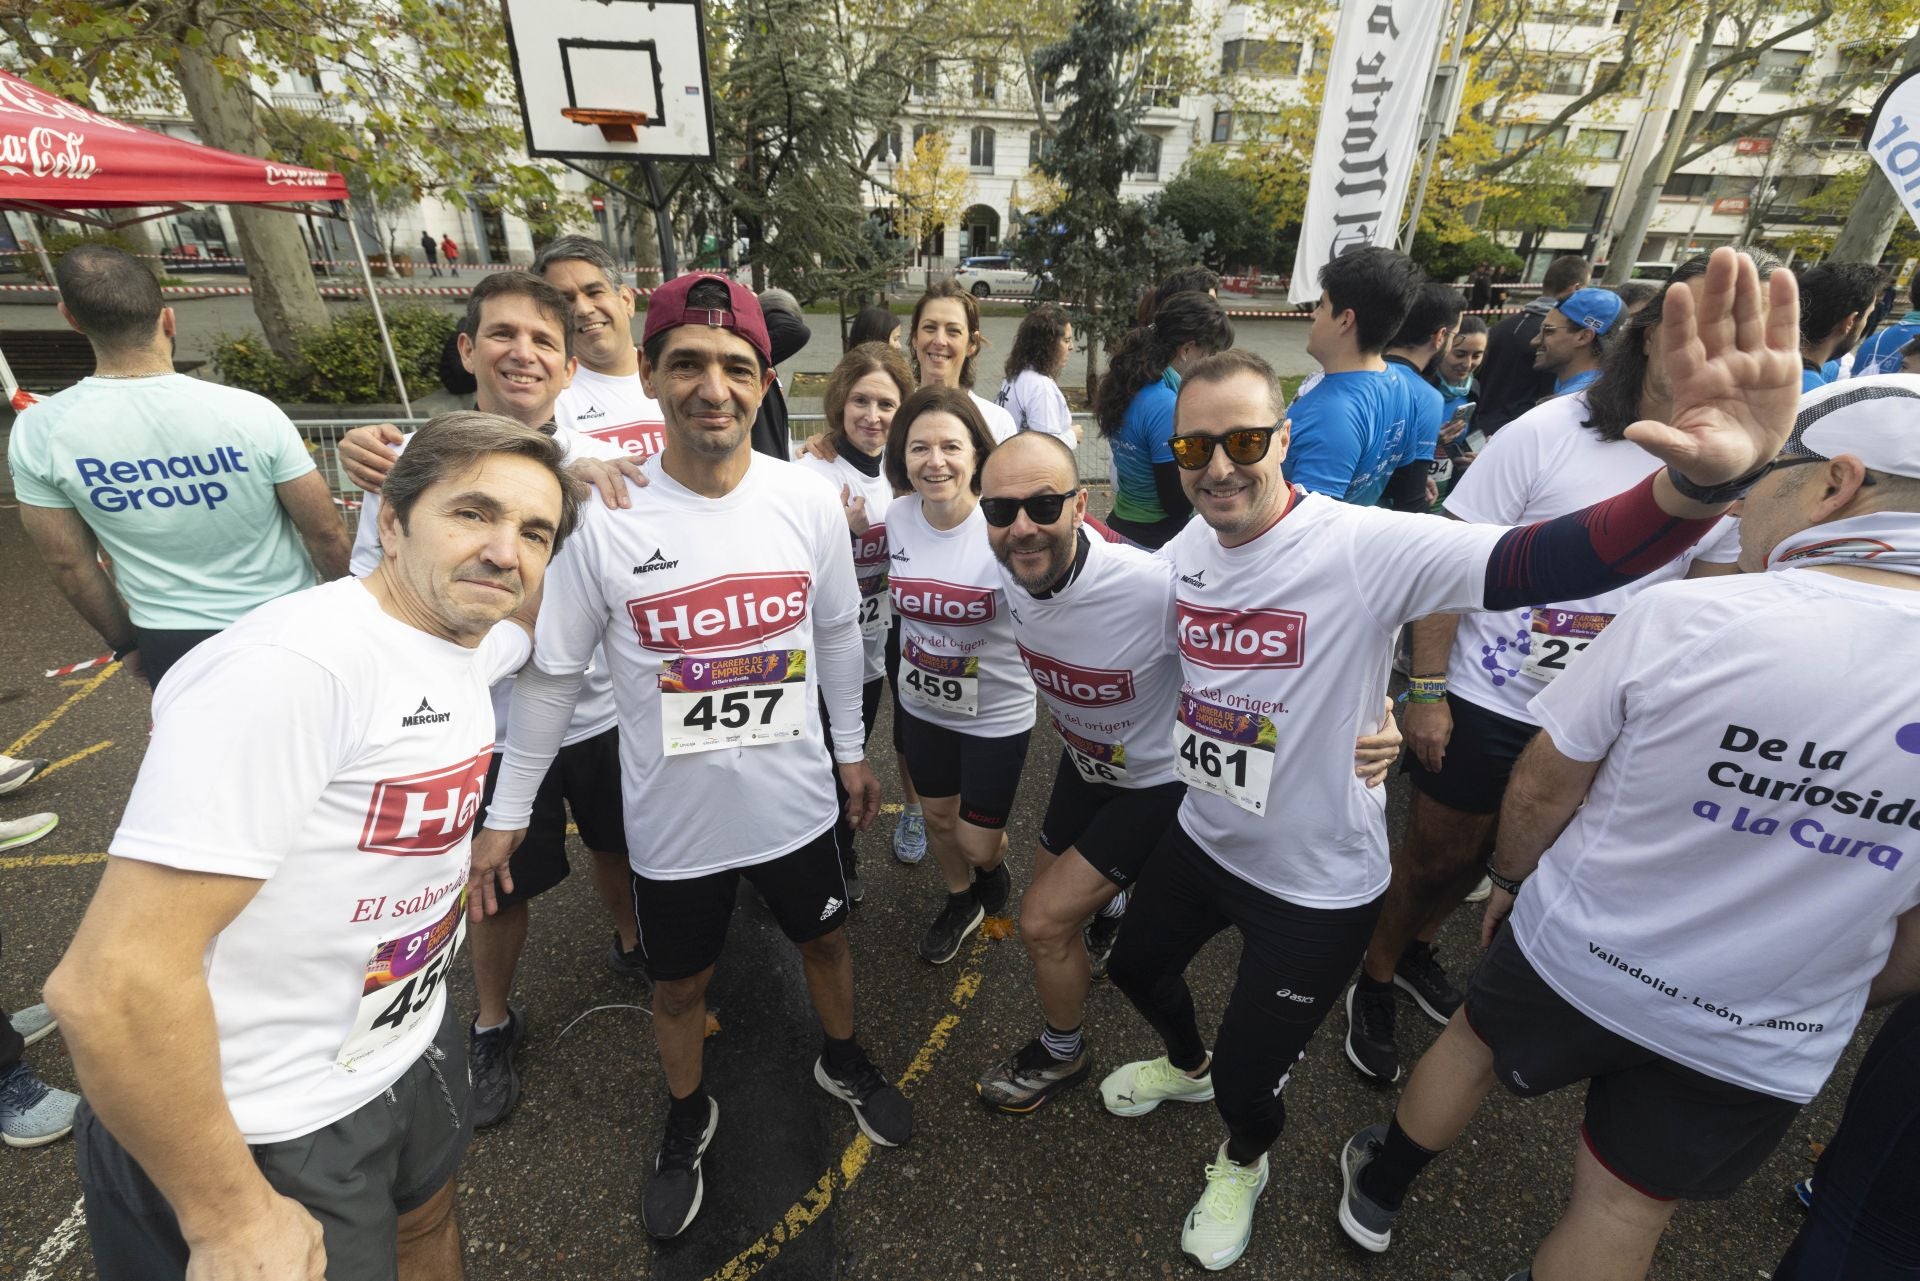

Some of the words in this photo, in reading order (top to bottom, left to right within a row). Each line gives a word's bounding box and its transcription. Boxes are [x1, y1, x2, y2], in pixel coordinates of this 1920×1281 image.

[1583, 317, 1601, 330] 25
[577, 412, 605, 420] MERCURY
[75, 446, 249, 487] Renault
[90, 482, 228, 512] Group
[633, 560, 679, 575] MERCURY
[645, 591, 804, 642] Helios
[928, 636, 946, 647] del
[691, 662, 710, 680] 9ª
[711, 657, 751, 670] CARRERA
[752, 656, 763, 665] DE
[711, 664, 763, 679] EMPRESAS
[906, 669, 962, 701] 459
[683, 688, 784, 732] 457
[1201, 686, 1222, 702] del
[1227, 694, 1289, 714] origen.
[402, 712, 450, 727] MERCURY
[1085, 720, 1135, 734] origen.
[1196, 713, 1234, 731] EMPRESAS
[1224, 711, 1235, 721] DE
[1180, 733, 1247, 787] 461
[1719, 724, 1788, 762] De
[1799, 741, 1847, 771] la
[1692, 800, 1721, 823] a
[1731, 806, 1780, 836] la
[1789, 818, 1903, 871] Cura
[350, 896, 387, 922] El
[405, 931, 430, 961] 9ª
[1589, 941, 1679, 997] Valladolid
[1692, 996, 1743, 1025] León
[1289, 993, 1315, 1004] asics
